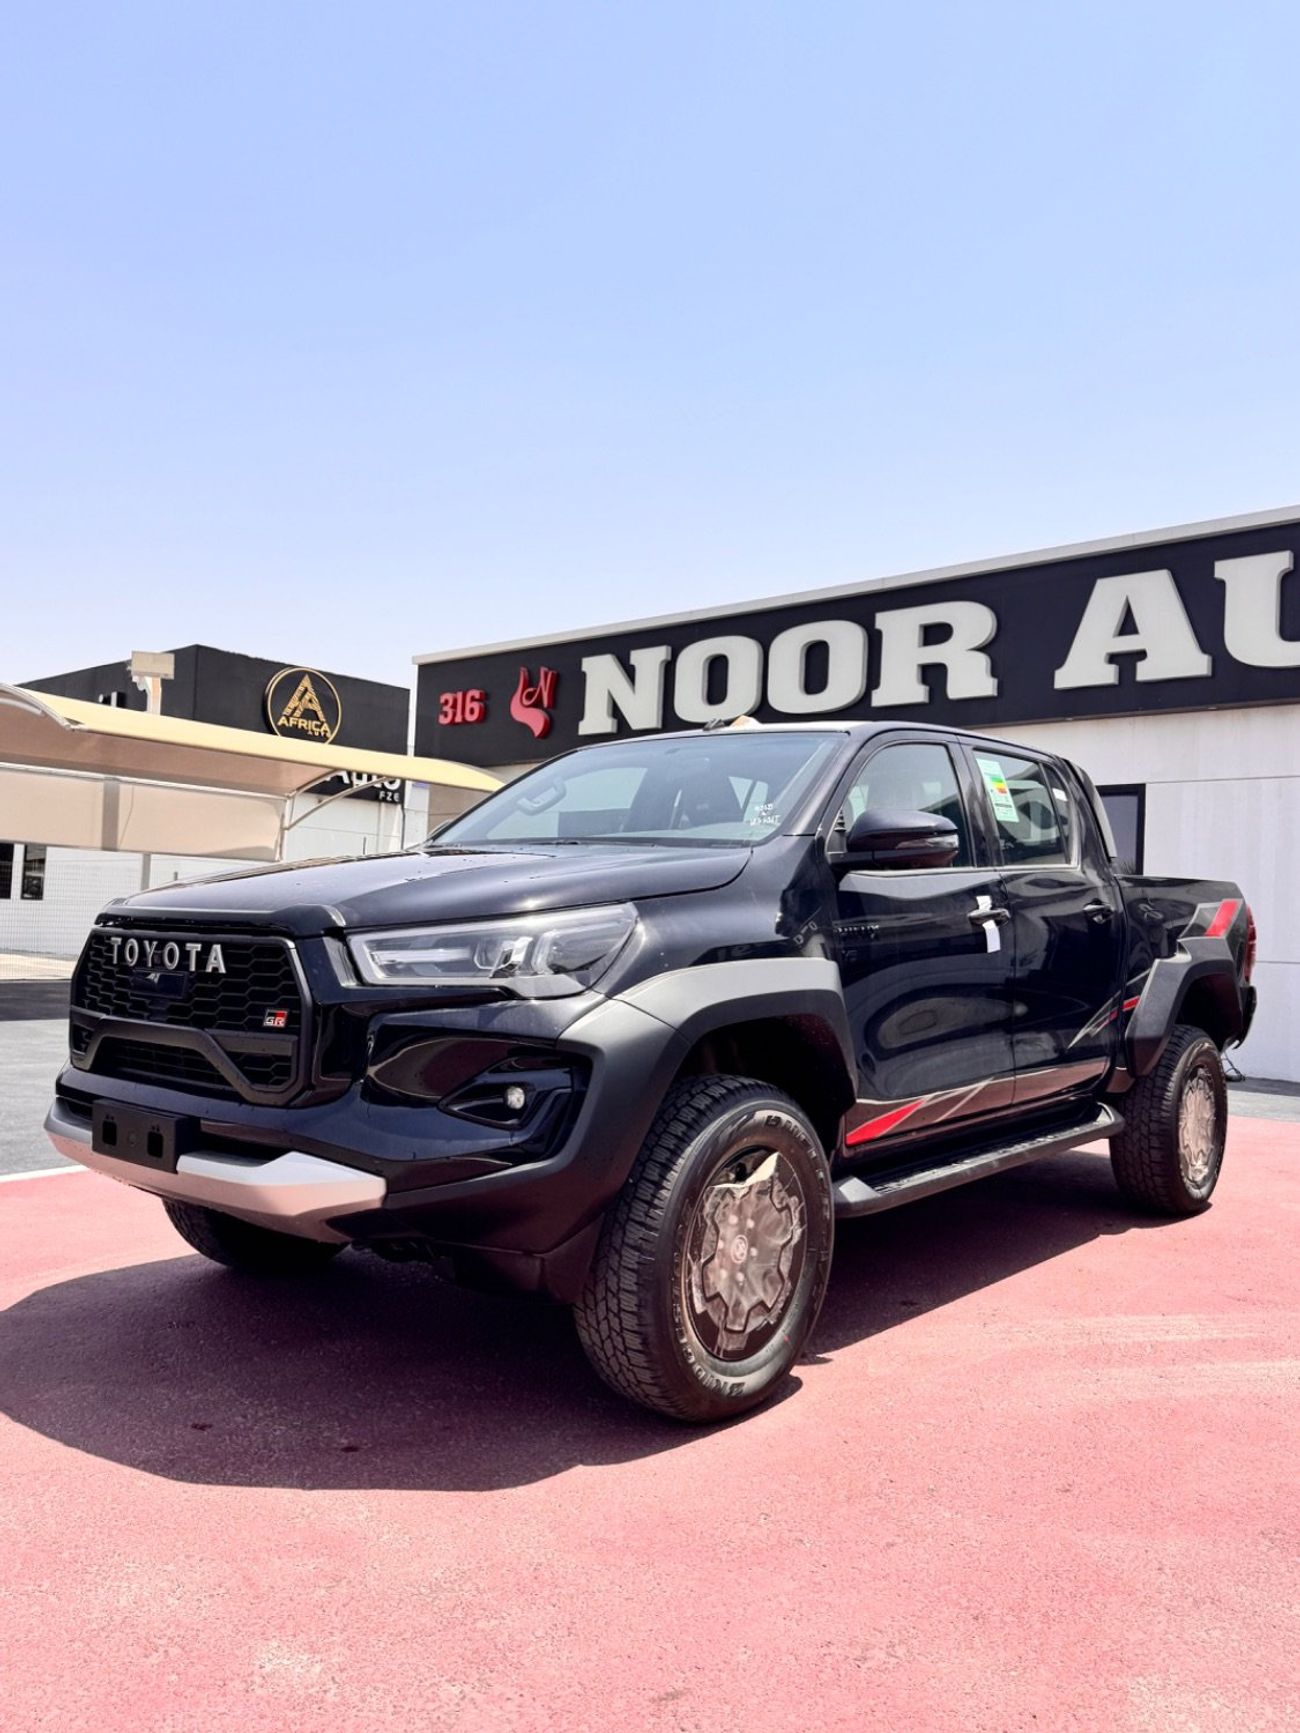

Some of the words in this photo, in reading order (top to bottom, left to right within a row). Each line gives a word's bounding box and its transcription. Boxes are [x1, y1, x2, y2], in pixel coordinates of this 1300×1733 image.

[578, 601, 999, 736] NOOR
[438, 688, 485, 725] 316
[277, 715, 332, 736] AFRICA
[379, 790, 400, 803] FZE
[111, 937, 226, 975] TOYOTA
[265, 1016, 285, 1026] GR
